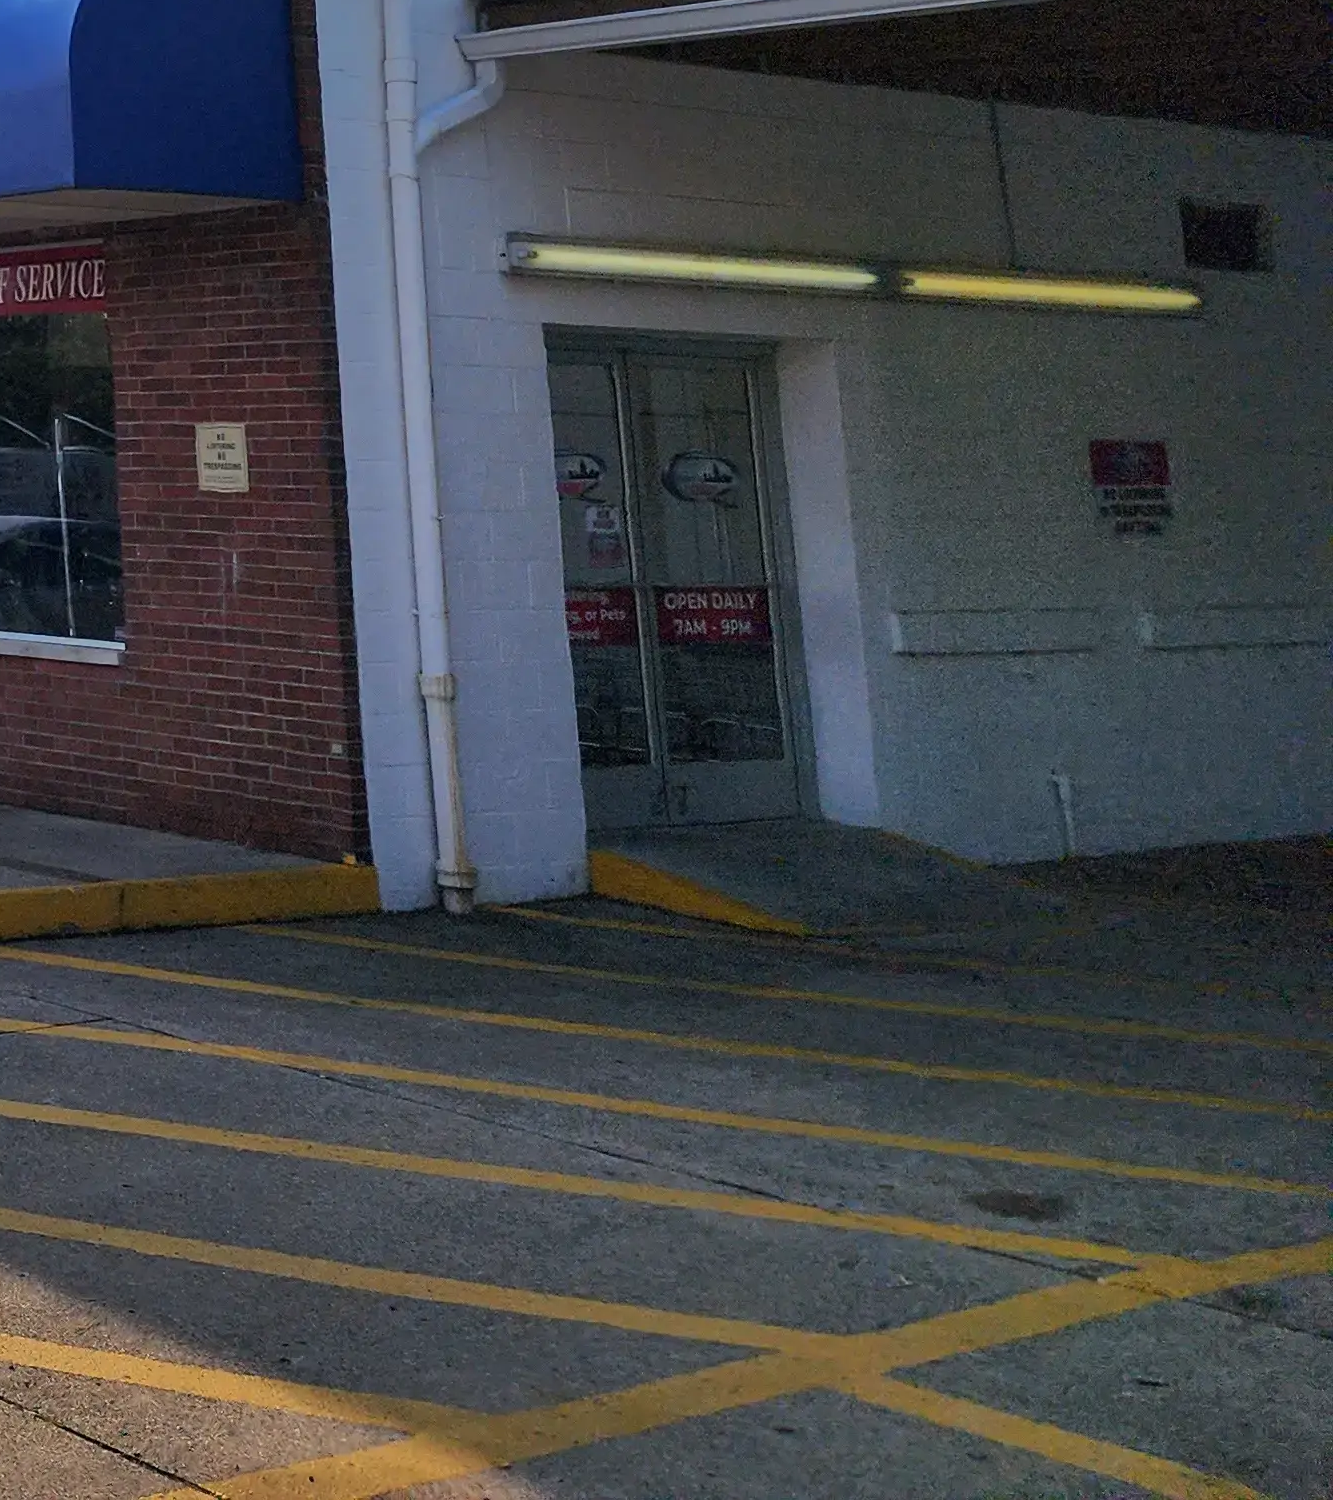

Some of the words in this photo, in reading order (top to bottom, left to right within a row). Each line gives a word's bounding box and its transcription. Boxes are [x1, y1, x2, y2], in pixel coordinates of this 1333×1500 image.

[14, 259, 106, 303] SERVICE
[663, 592, 708, 610] OPEN
[711, 592, 758, 610] DAILY
[672, 619, 708, 636] 7AM
[720, 618, 752, 635] 9PM
